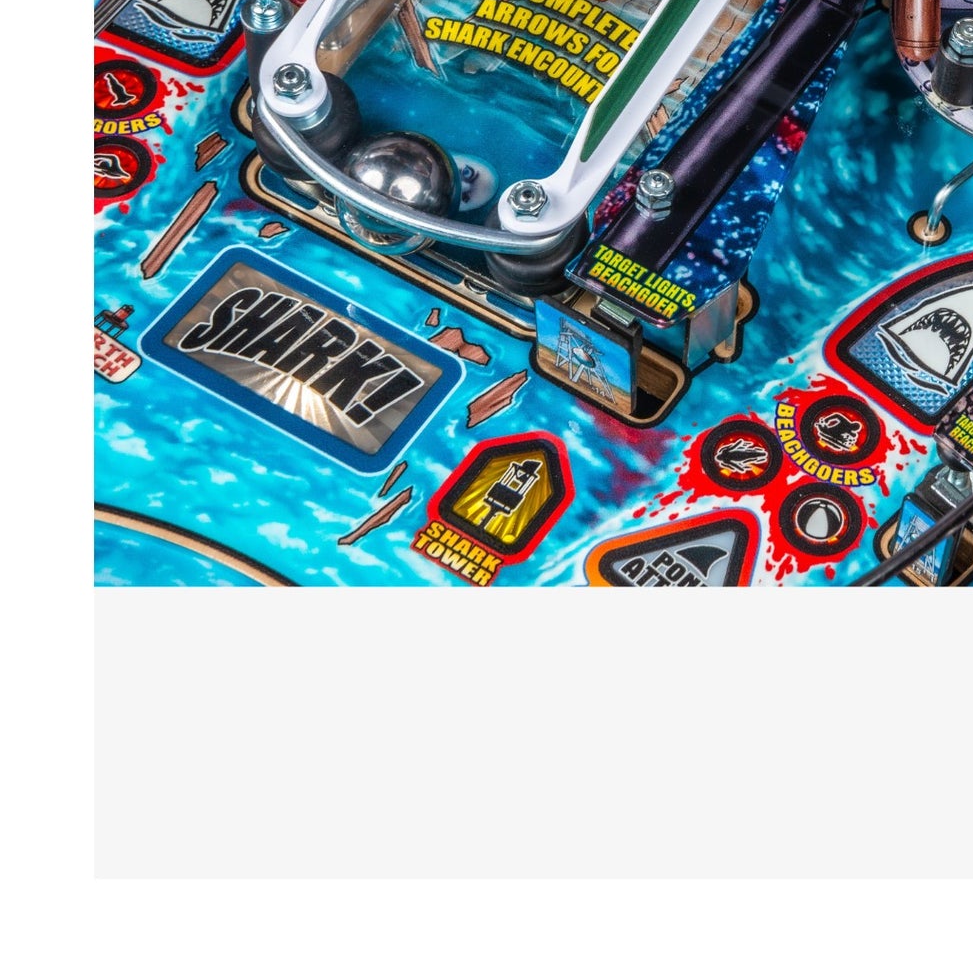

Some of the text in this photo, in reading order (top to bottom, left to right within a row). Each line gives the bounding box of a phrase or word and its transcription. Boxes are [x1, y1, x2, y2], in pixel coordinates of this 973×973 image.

[424, 17, 510, 54] SHARK
[583, 43, 623, 77] FO
[588, 262, 679, 318] BEACHGOER
[593, 244, 697, 313] TARGET LIGHTS,
[177, 287, 425, 428] SHARK!
[776, 402, 876, 485] BEACHGOERS
[414, 533, 492, 586] TOWER
[425, 521, 502, 573] SHARK
[650, 550, 708, 587] PON
